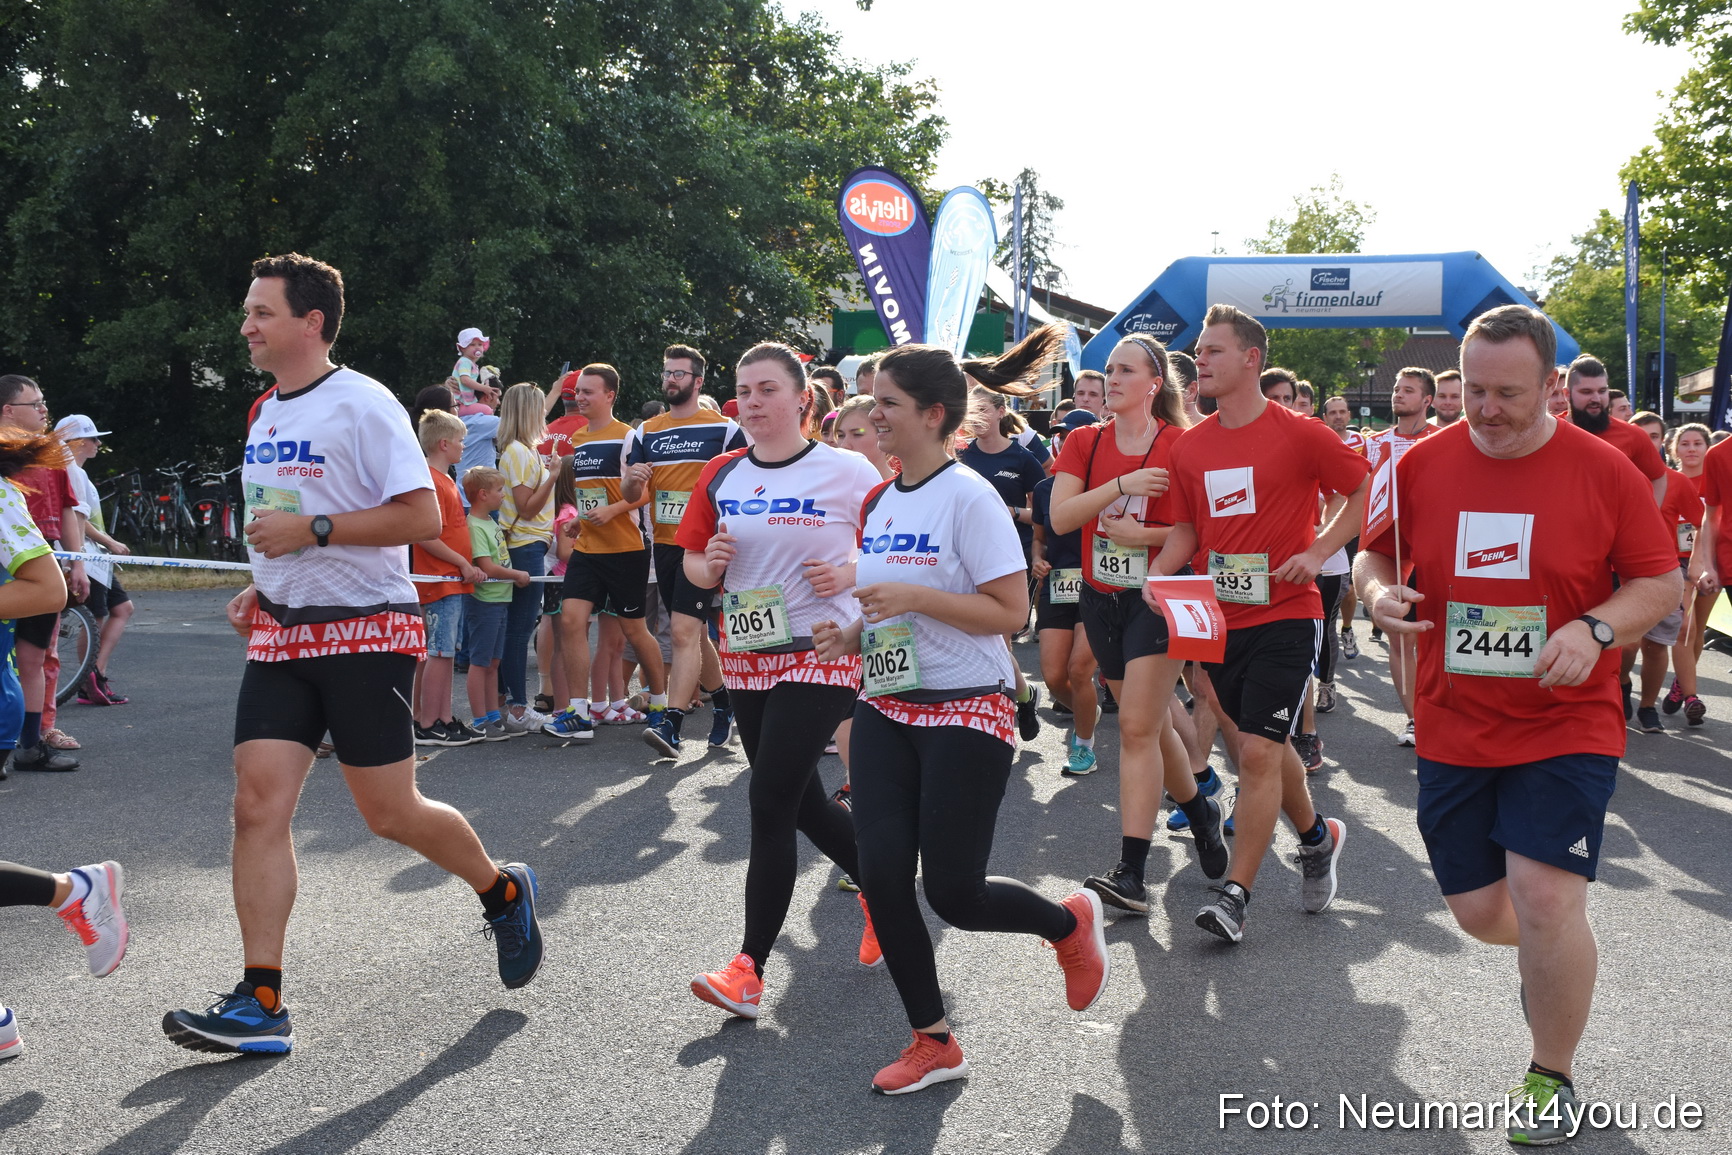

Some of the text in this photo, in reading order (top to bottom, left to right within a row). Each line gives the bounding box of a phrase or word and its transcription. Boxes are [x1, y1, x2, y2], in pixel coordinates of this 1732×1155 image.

[1319, 275, 1348, 284] Fischer
[1296, 291, 1384, 307] firmenlauf
[1132, 320, 1178, 331] Fischer
[659, 441, 704, 451] Fischer
[573, 458, 604, 467] Fischer
[277, 461, 324, 478] energie
[580, 499, 598, 511] 762
[661, 502, 685, 515] 777
[767, 514, 826, 527] energie
[886, 552, 938, 566] energie
[1481, 550, 1505, 562] DEHN
[1100, 555, 1130, 574] 481
[1053, 580, 1082, 594] 1440
[1216, 571, 1252, 590] 493
[729, 608, 775, 635] 2061
[1460, 617, 1497, 627] firmenlauf
[736, 630, 775, 641] Bauer Stephanie
[1456, 629, 1533, 658] 2444
[867, 648, 909, 678] 2062
[886, 674, 905, 682] Maryam
[1568, 846, 1589, 858] adidas
